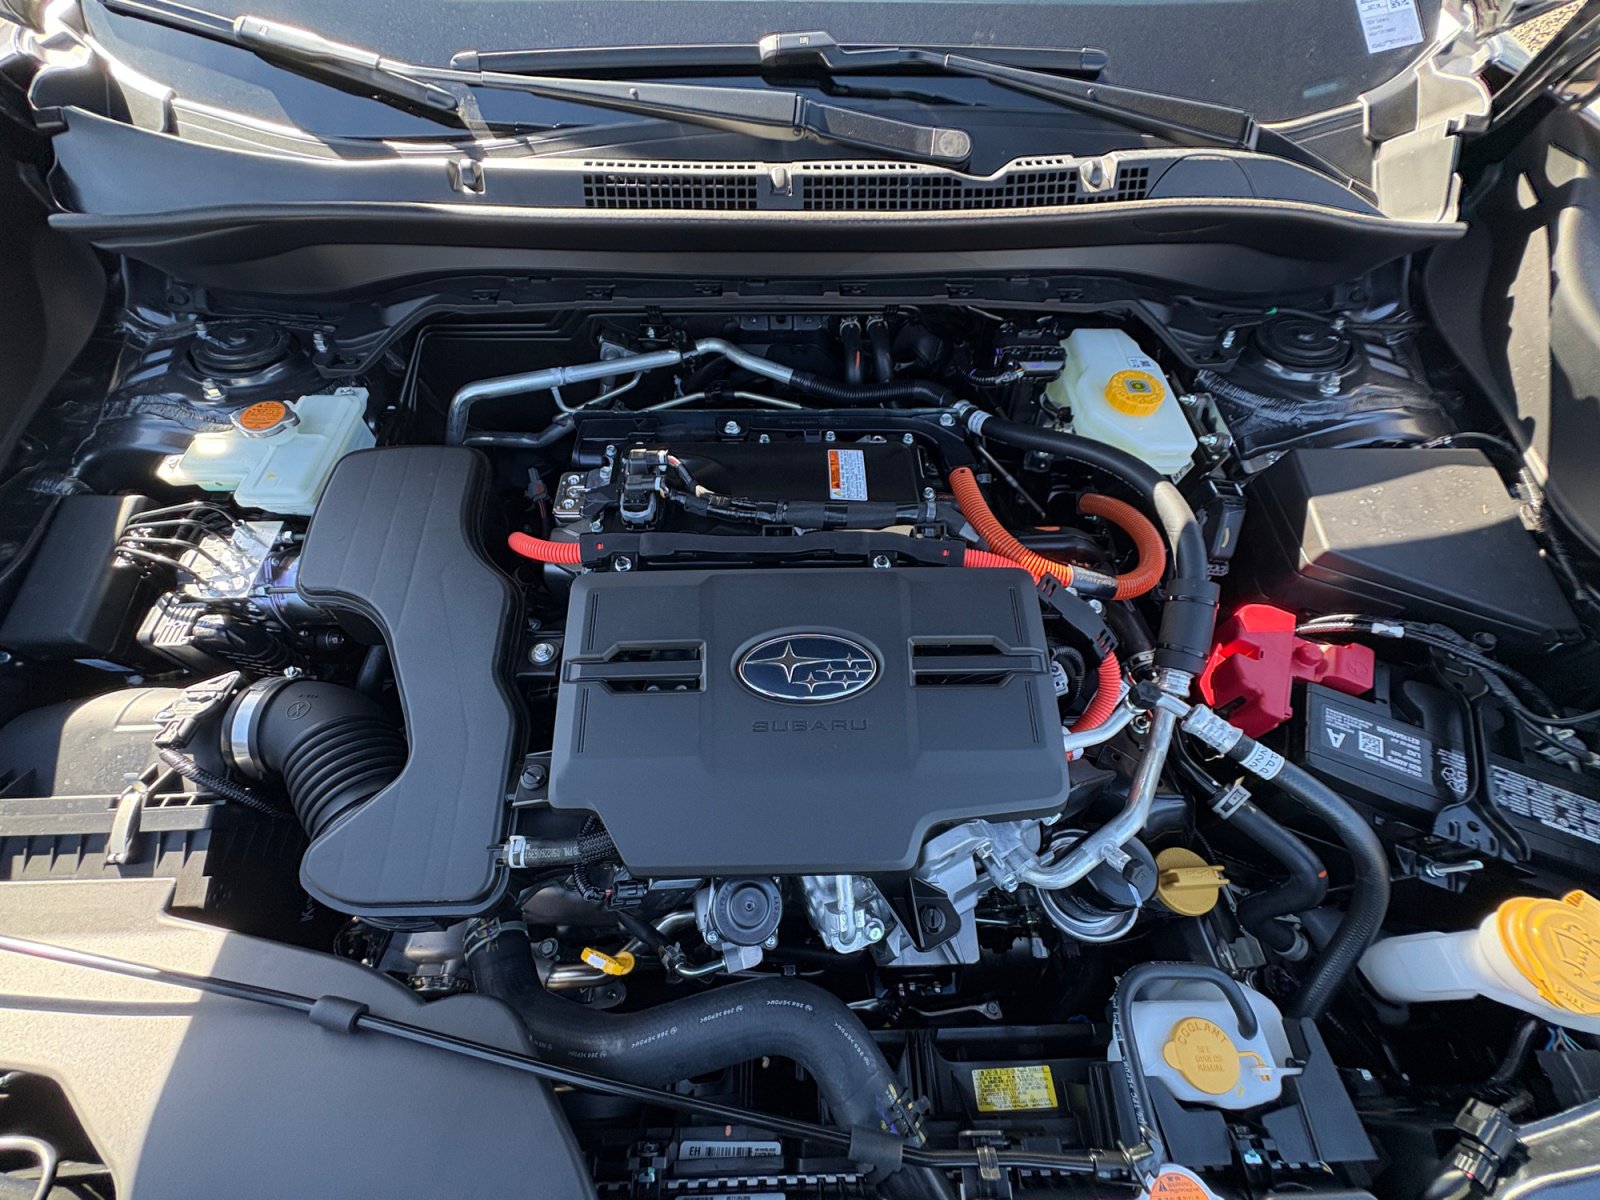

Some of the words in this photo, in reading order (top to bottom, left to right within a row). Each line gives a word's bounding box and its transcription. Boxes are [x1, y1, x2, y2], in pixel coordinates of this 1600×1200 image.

[752, 719, 868, 733] SUBARU
[1326, 727, 1346, 748] A
[1178, 1021, 1228, 1045] COOLANT
[689, 1146, 701, 1157] EH
